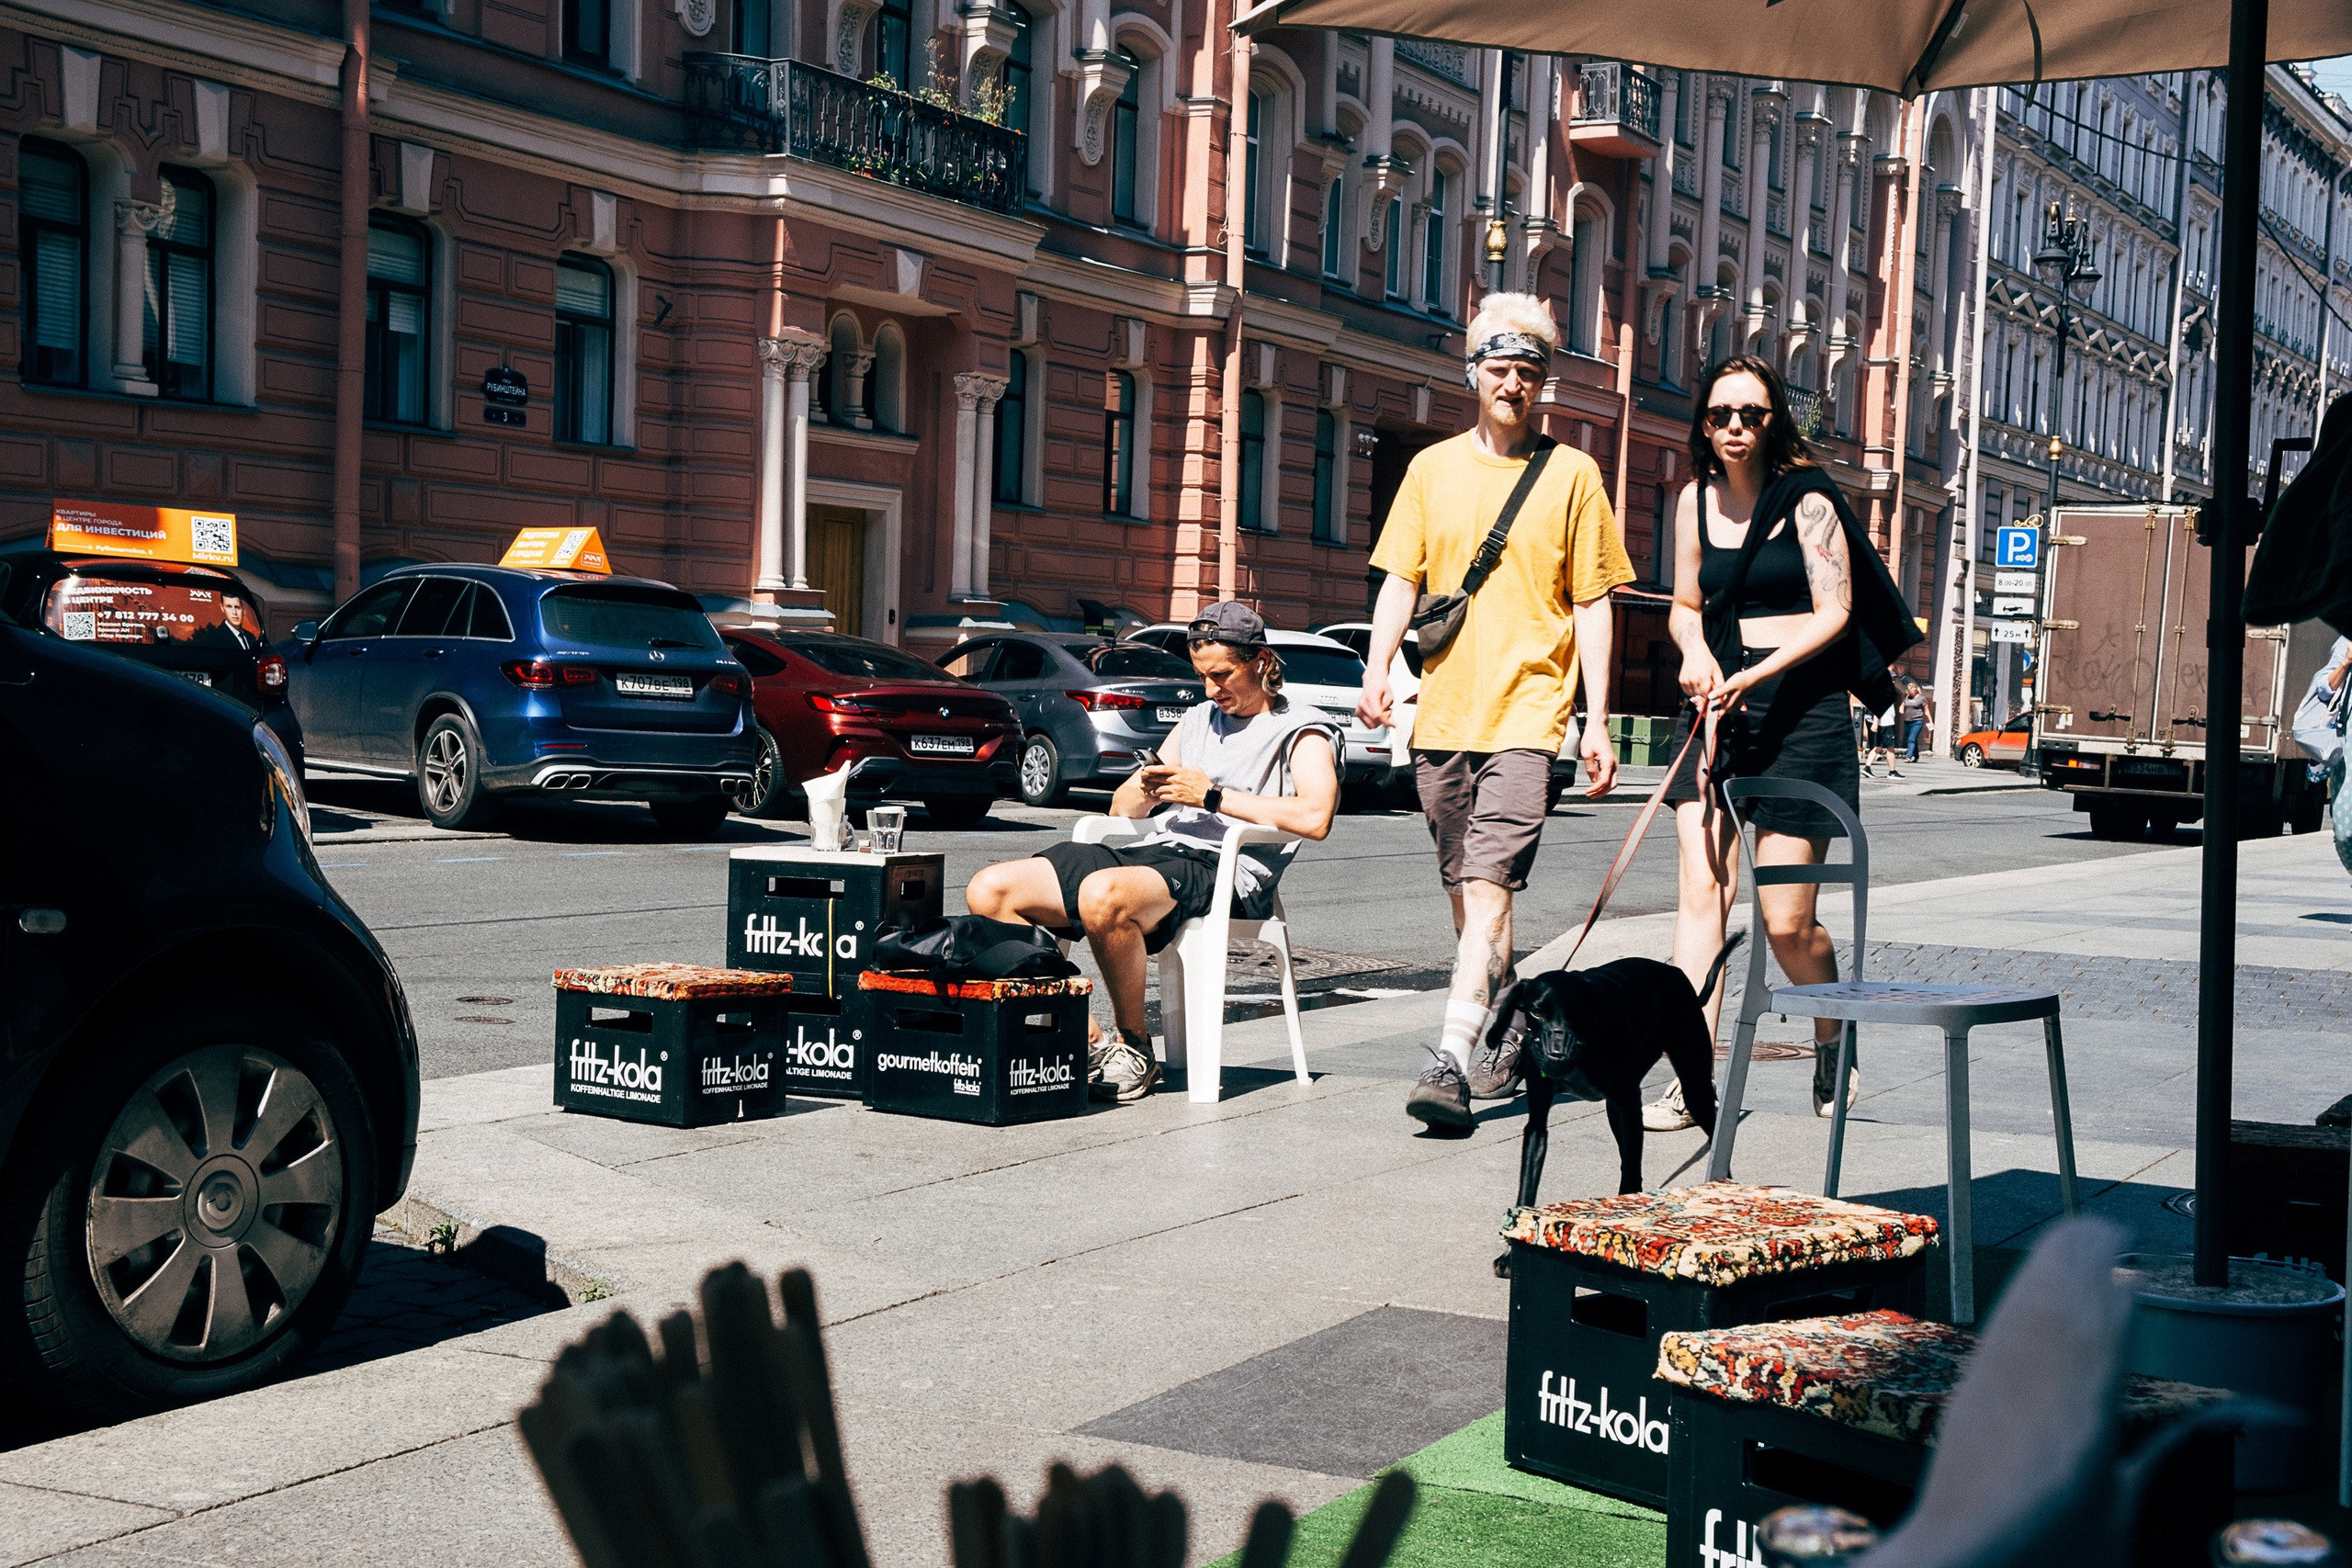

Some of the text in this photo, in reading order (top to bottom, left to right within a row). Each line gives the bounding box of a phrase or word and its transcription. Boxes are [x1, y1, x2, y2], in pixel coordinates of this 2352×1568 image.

[486, 382, 526, 397] РУБИНШТЕЙНА
[503, 412, 508, 422] 3
[56, 509, 96, 517] КВАРТИРЫ
[93, 518, 123, 526] ГОРОДА
[56, 522, 166, 540] ДЛЯ ИНВЕСТИЦИЙ
[72, 596, 114, 605] ЦЕНТРЕ
[97, 611, 195, 624] +7 812 777 34 00
[672, 677, 690, 688] 198
[956, 738, 970, 747] 198
[877, 1050, 980, 1078] gourmetkoffein
[811, 1068, 853, 1080] LIMONADE
[570, 1083, 662, 1104] KOFFEINHALTIGE LIMONADE
[702, 1081, 768, 1095] KOFFEINHALTIGE LIMONADE
